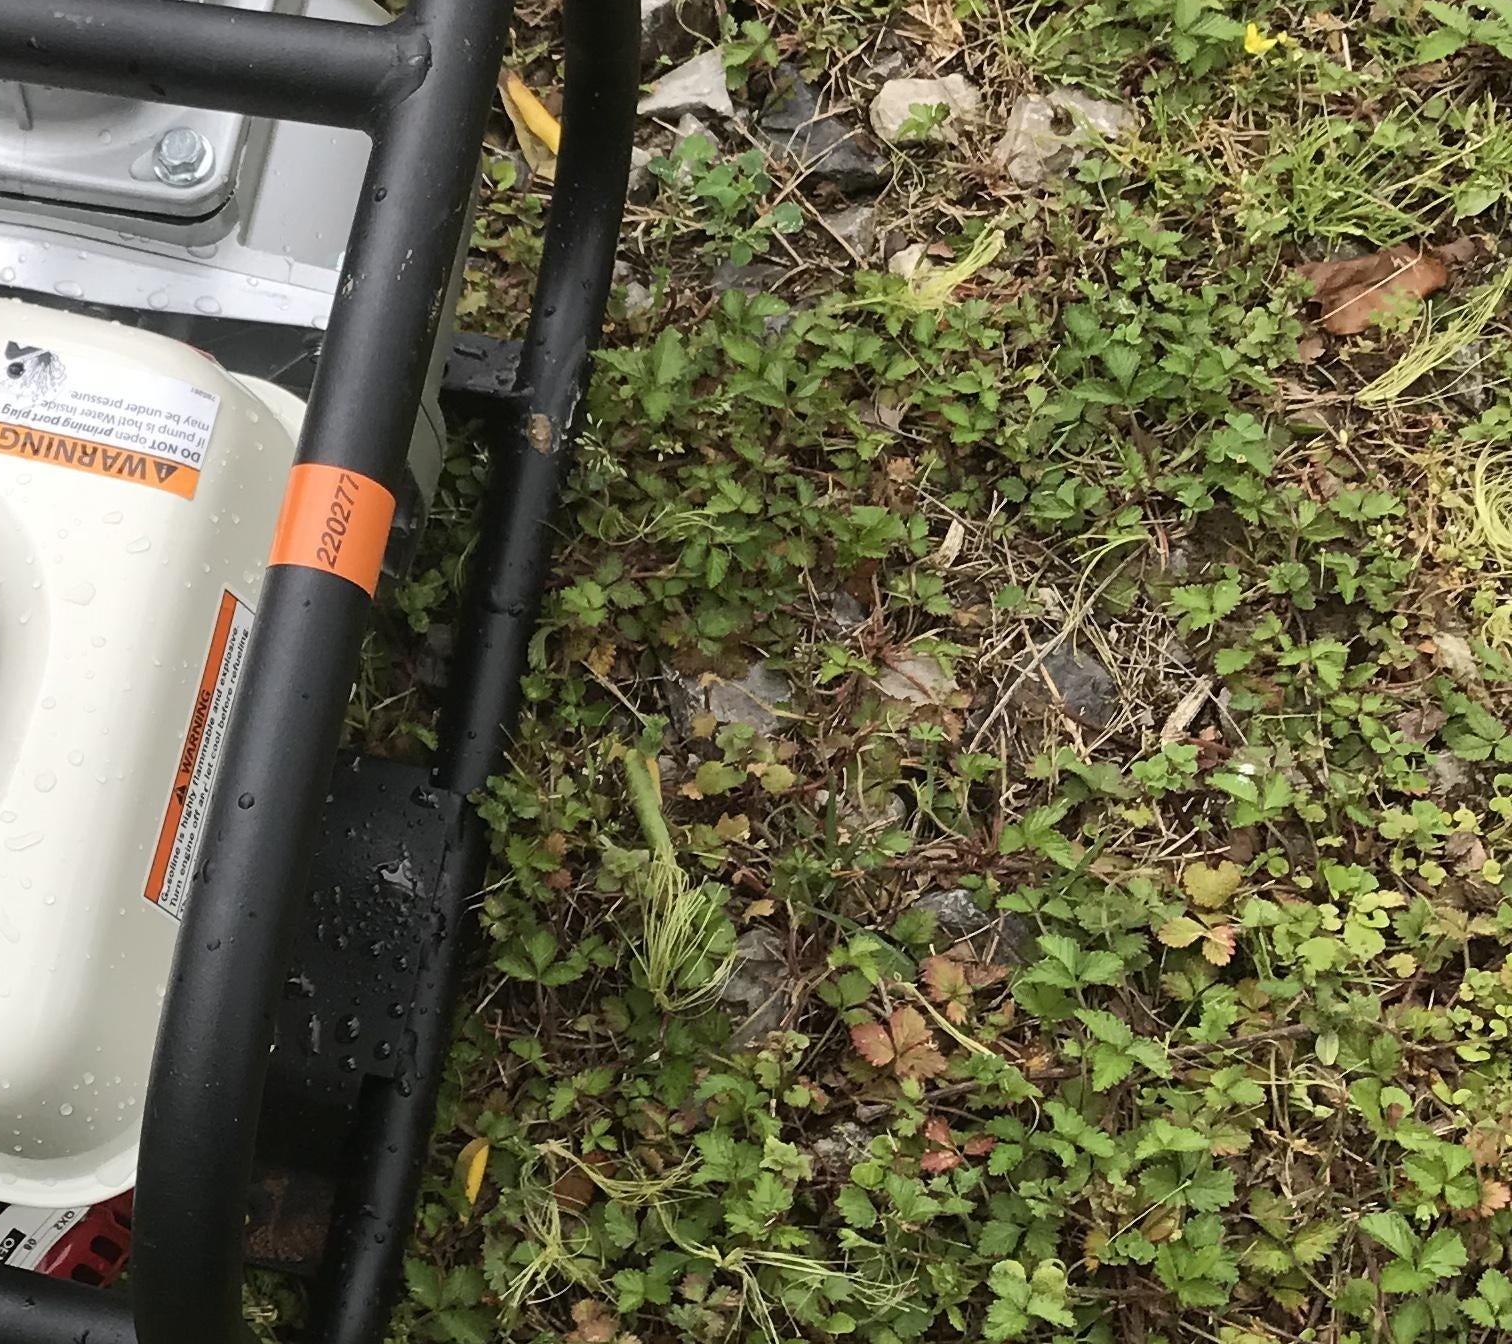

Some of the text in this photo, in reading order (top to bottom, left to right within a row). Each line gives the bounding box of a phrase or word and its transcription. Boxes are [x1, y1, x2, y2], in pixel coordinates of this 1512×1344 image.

[41, 400, 78, 416] inside
[81, 408, 115, 424] Water
[128, 404, 162, 419] under
[119, 415, 142, 430] hot!
[145, 422, 154, 433] is
[165, 412, 178, 426] be
[183, 417, 210, 432] may
[1, 404, 201, 463] DO NOT open priming port plug
[159, 425, 196, 443] pump
[316, 472, 360, 569] 220277
[182, 689, 211, 774] WARNING
[177, 834, 185, 843] is
[181, 791, 198, 828] highly
[192, 717, 214, 786] flammable
[213, 689, 223, 715] and
[169, 880, 182, 907] Turn
[180, 832, 194, 876] engine
[193, 811, 201, 828] off
[205, 764, 214, 779] let
[211, 731, 222, 760] cool
[218, 688, 233, 729] before
[52, 1210, 75, 1231] QX2
